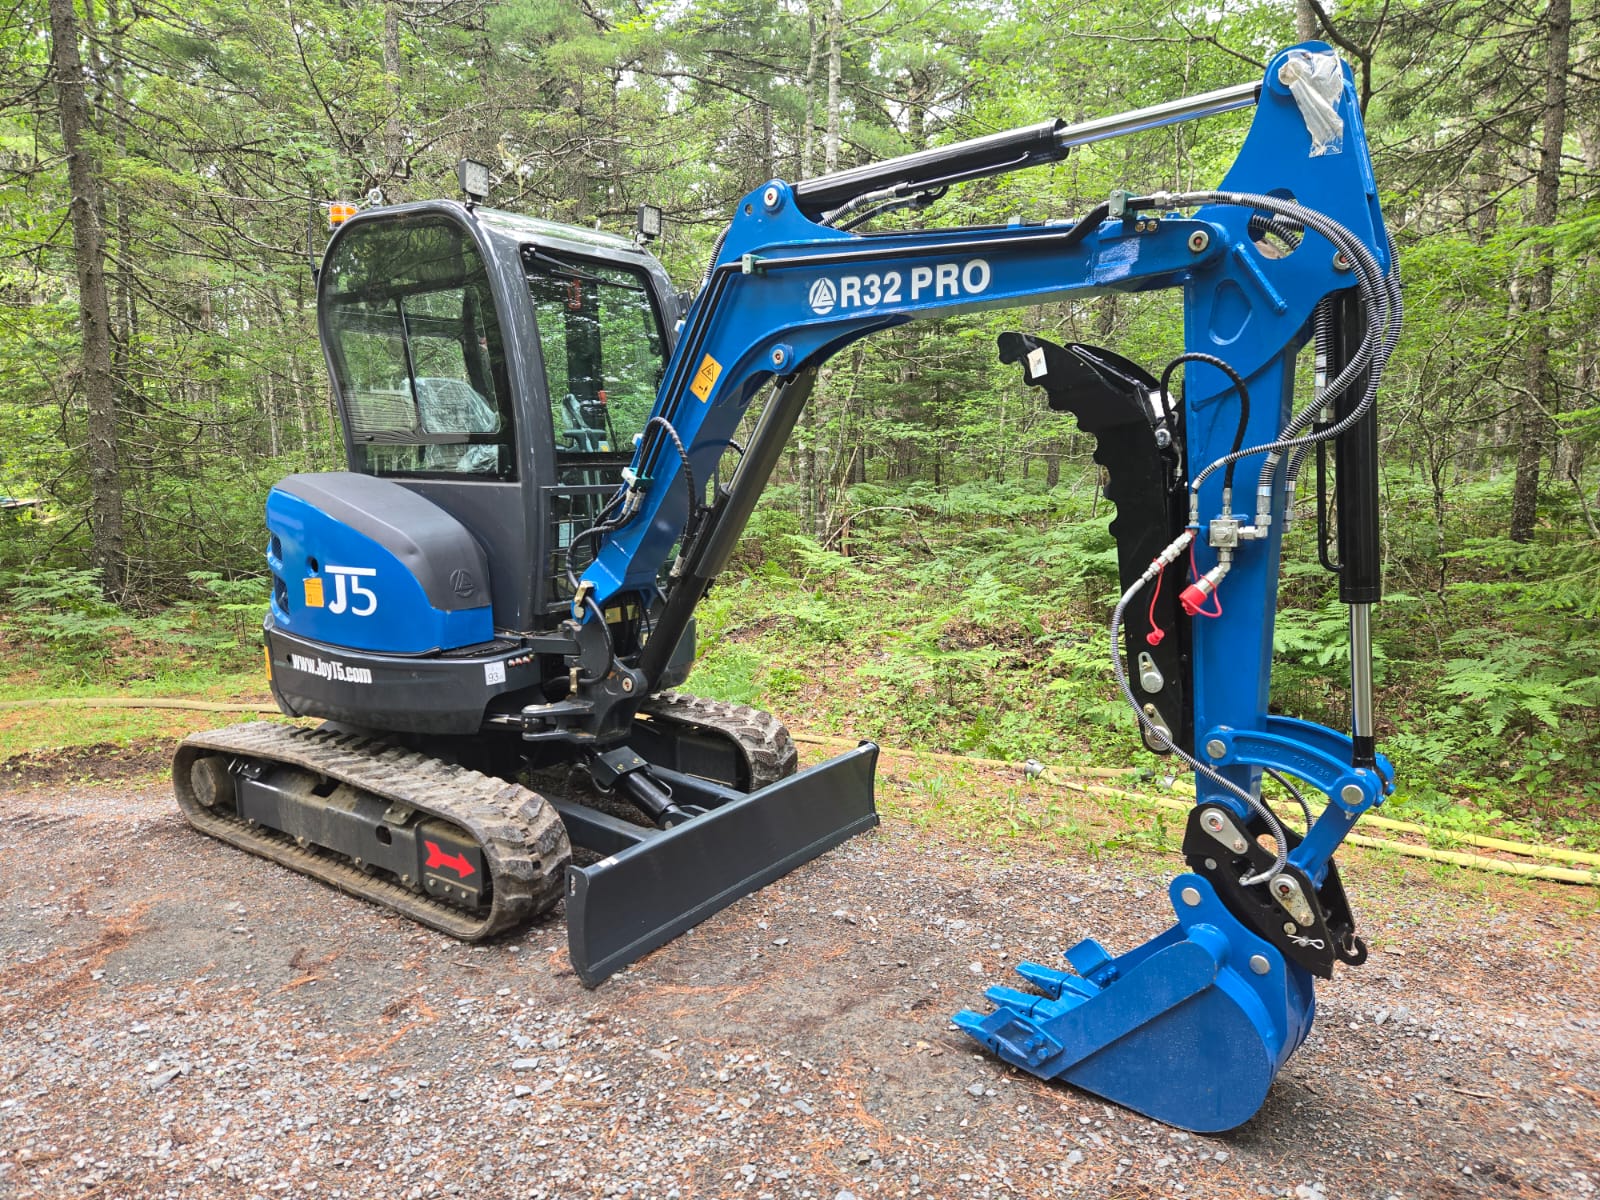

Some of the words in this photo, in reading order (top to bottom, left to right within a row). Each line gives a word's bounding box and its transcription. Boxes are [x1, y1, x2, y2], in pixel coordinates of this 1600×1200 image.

[840, 271, 902, 308] R32
[911, 258, 991, 300] PRO
[291, 653, 373, 684] www.JoyT5.com
